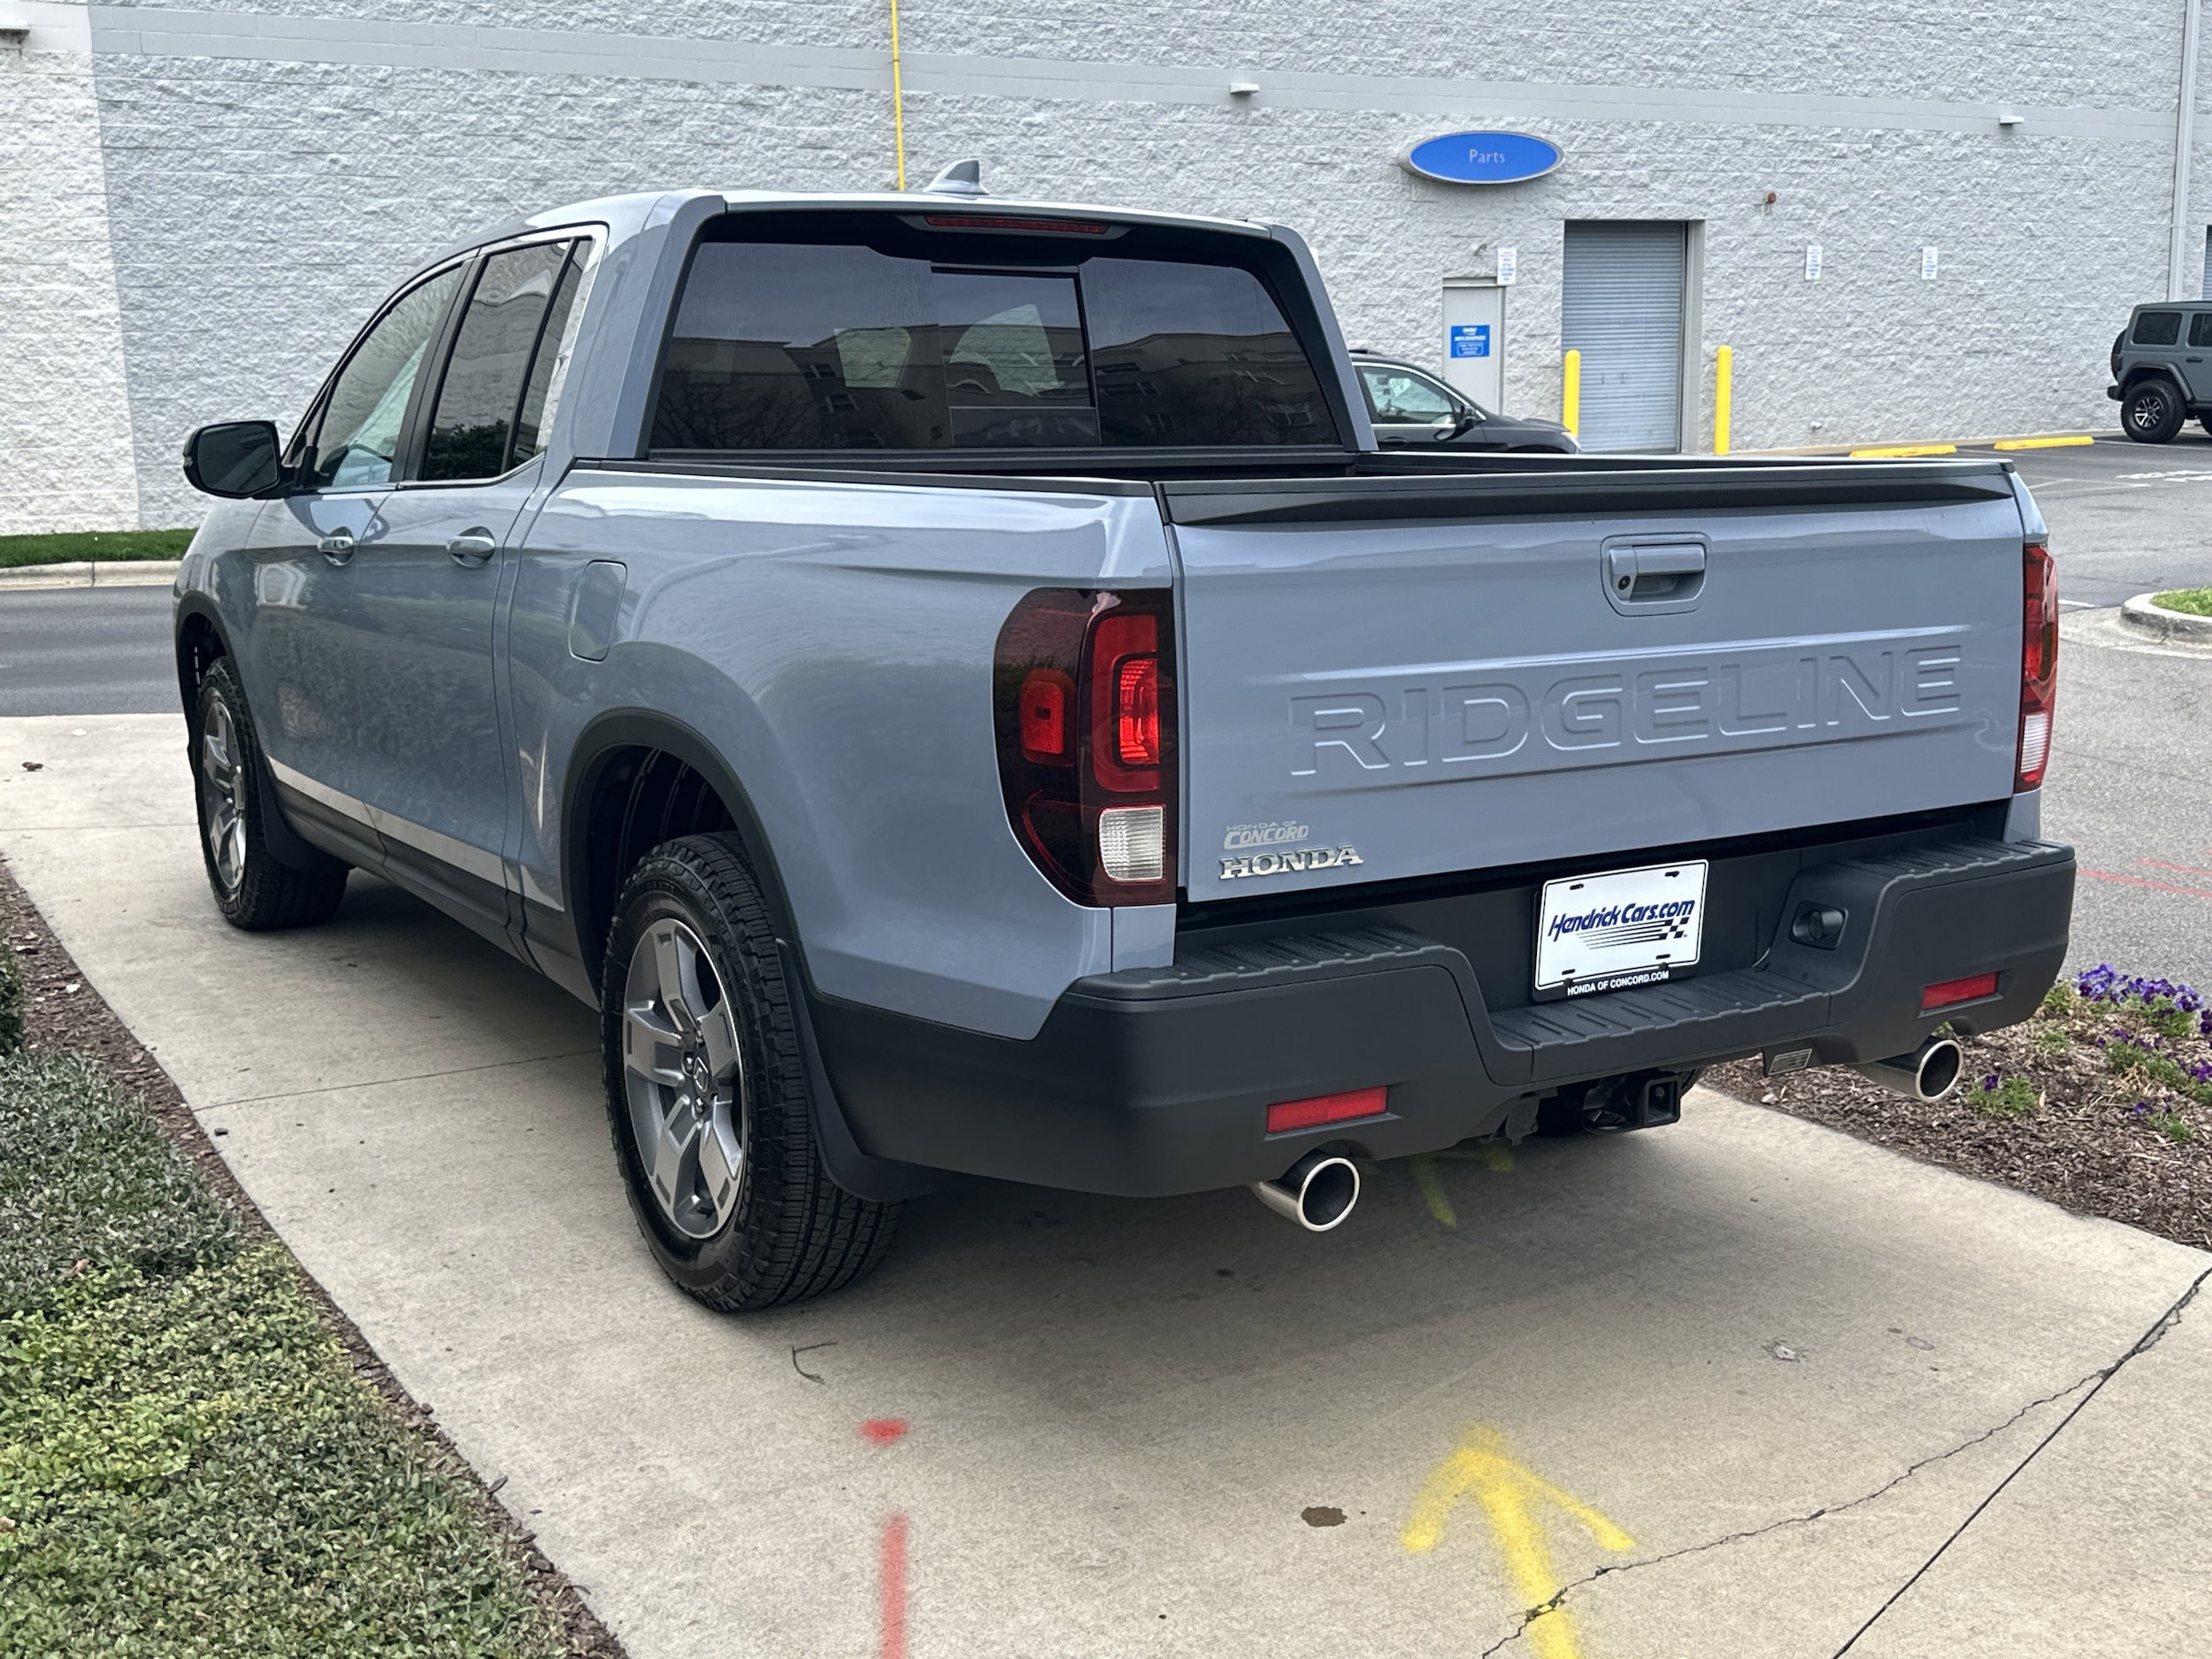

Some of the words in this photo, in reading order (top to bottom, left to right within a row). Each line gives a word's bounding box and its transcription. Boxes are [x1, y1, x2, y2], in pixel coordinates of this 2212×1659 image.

[1469, 148, 1506, 164] Parts
[1289, 644, 1962, 776] RIDGELINE
[1224, 825, 1310, 849] CONCORD
[1226, 822, 1279, 831] HONDA
[1218, 844, 1364, 880] HONDA
[1567, 981, 1595, 995] HONDA
[1597, 979, 1609, 991] OF
[1609, 971, 1670, 989] CONCORD.COM
